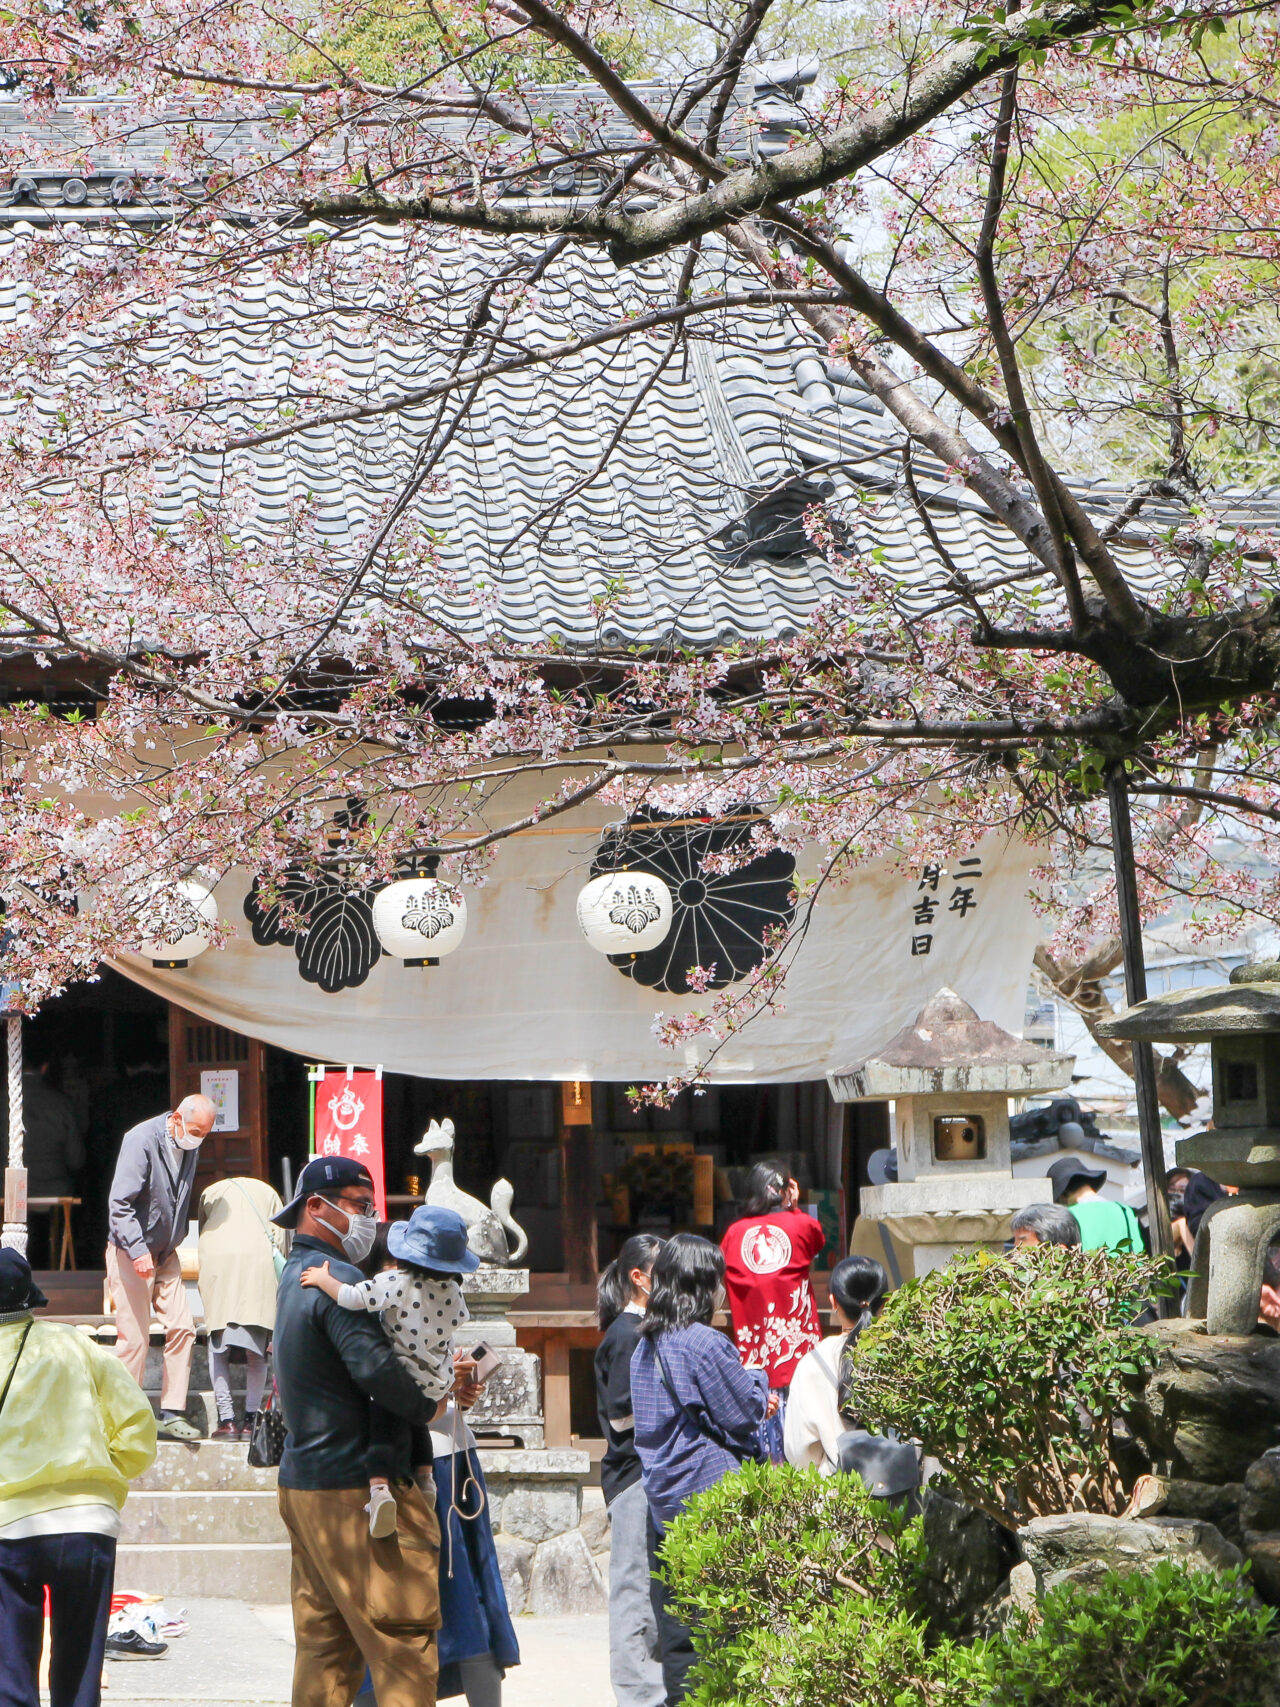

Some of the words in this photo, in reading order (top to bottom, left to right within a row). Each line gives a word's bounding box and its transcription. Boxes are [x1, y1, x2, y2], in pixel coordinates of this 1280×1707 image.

[911, 863, 943, 956] 月吉日
[948, 858, 983, 918] 二年
